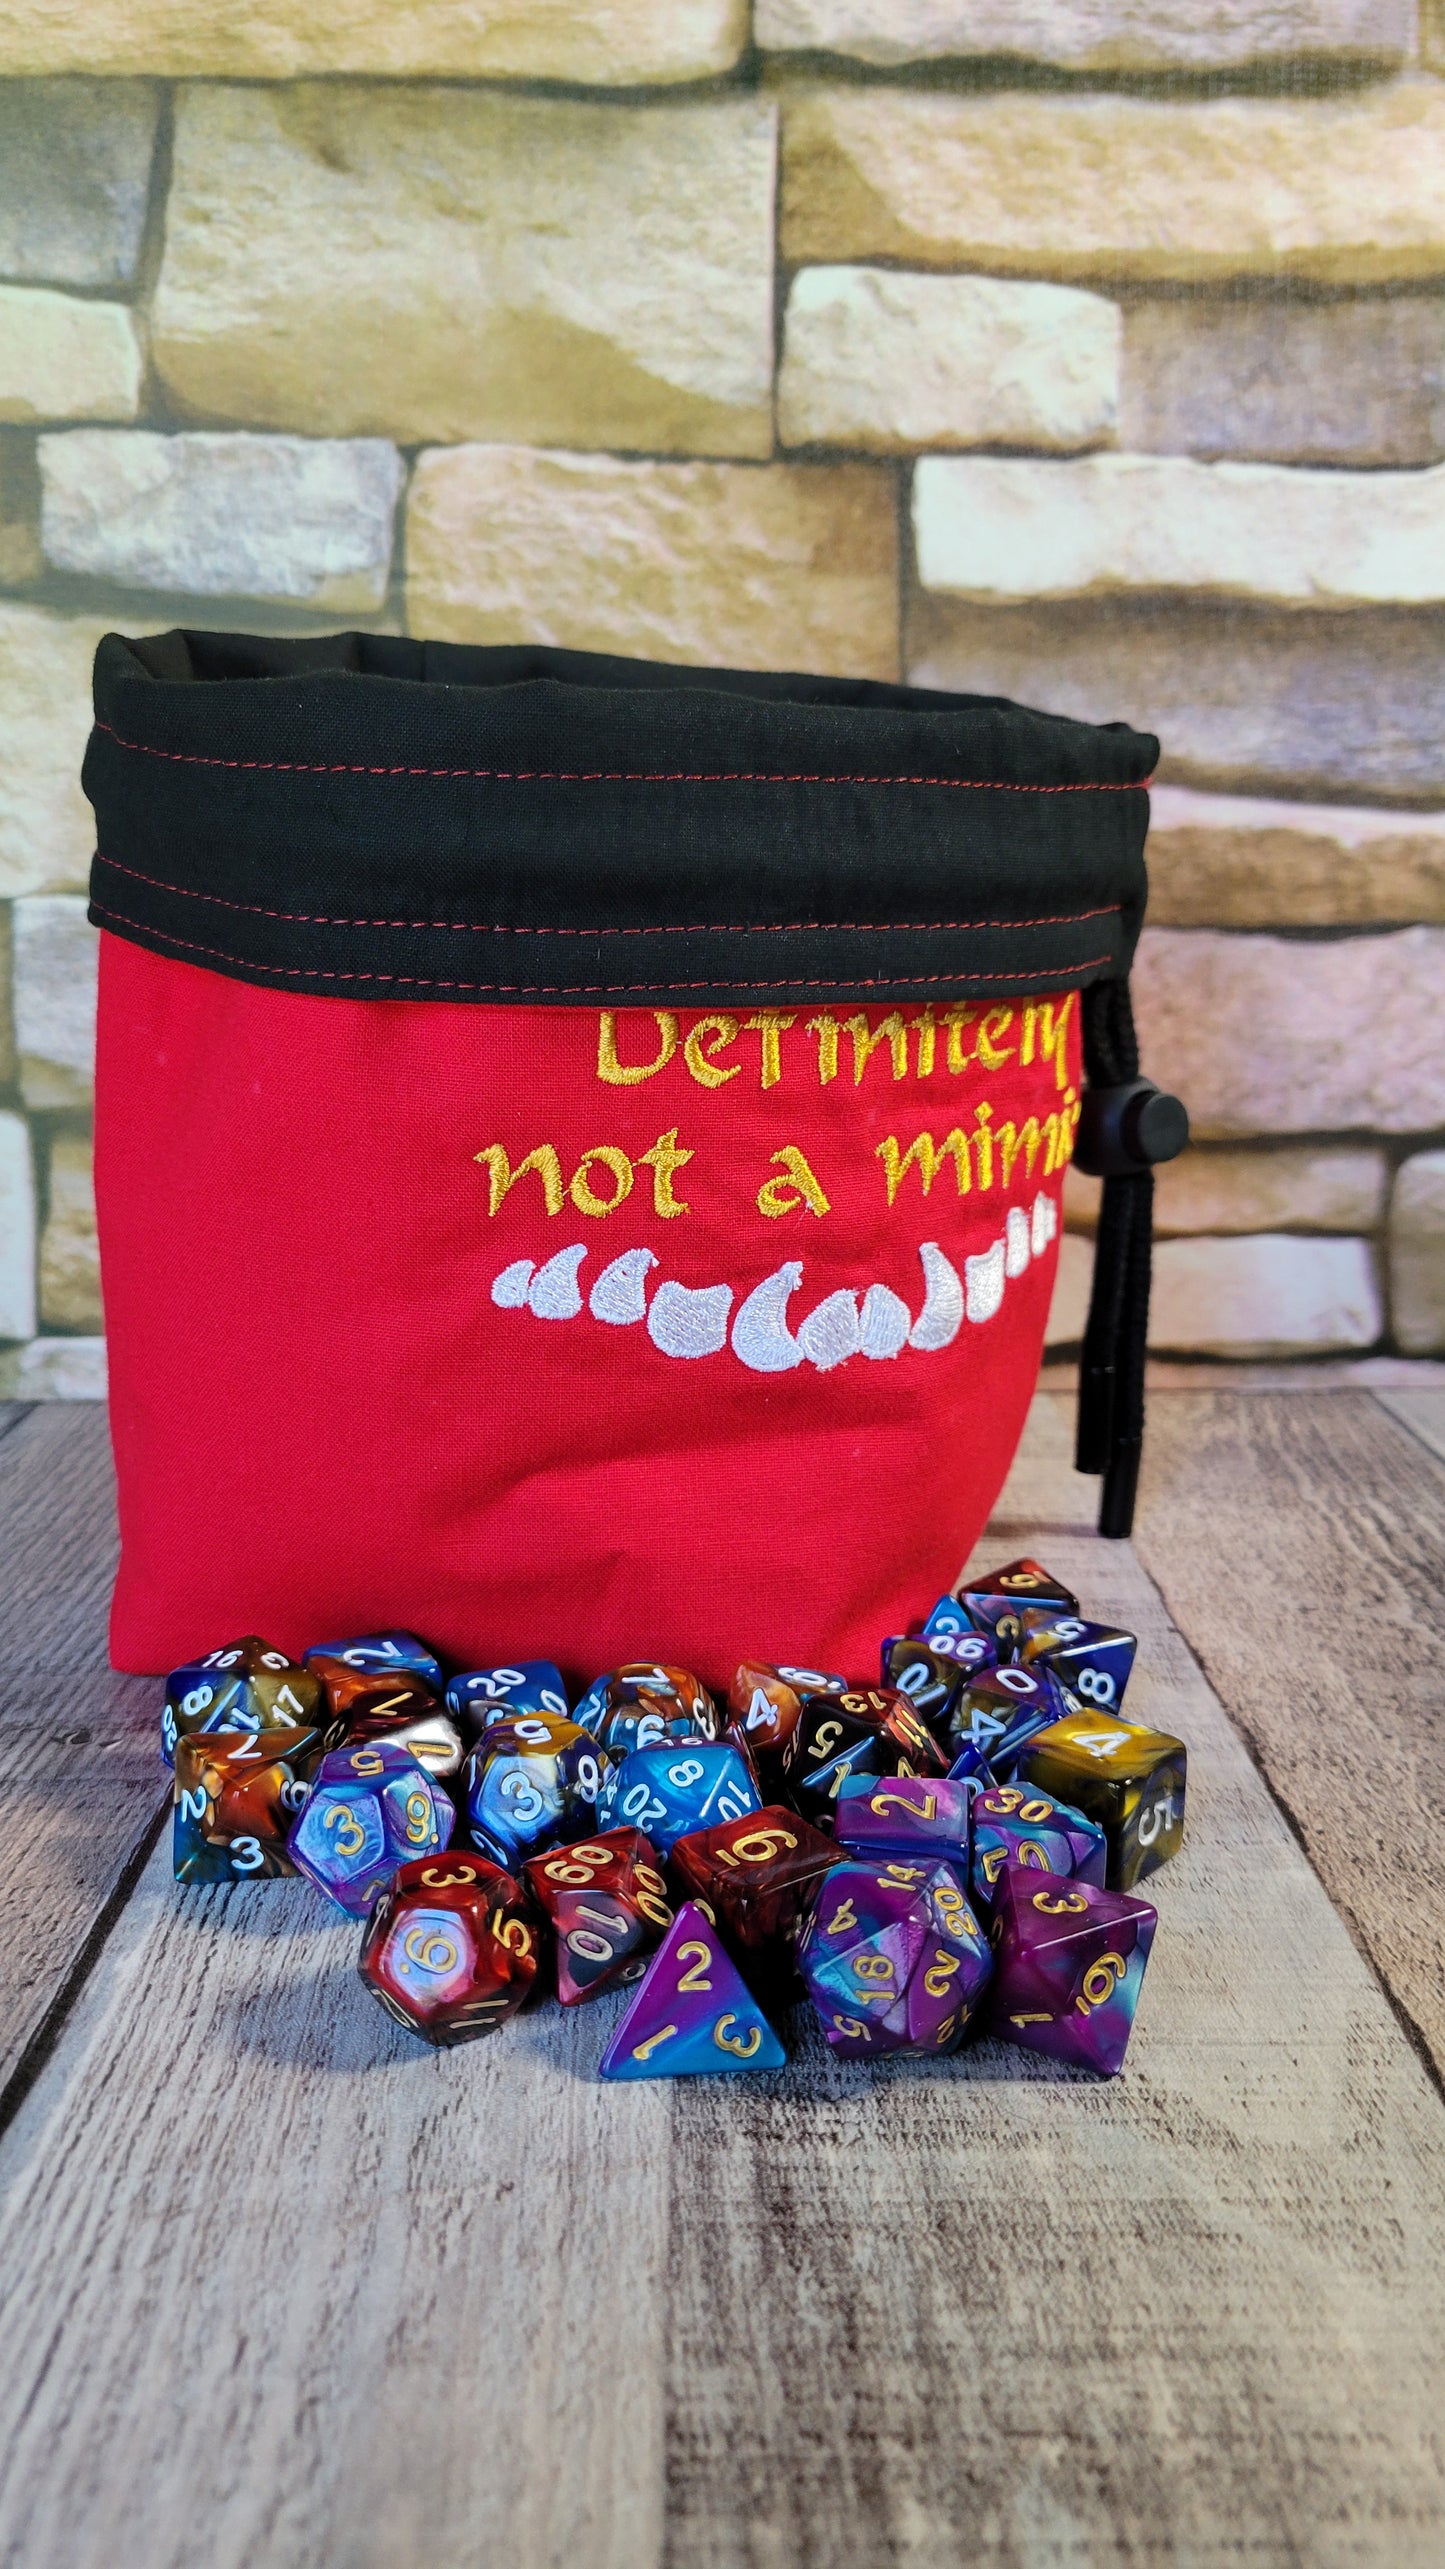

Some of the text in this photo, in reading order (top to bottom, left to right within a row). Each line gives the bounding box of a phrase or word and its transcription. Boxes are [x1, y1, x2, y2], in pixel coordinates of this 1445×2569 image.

[473, 1127, 694, 1219] not
[757, 1145, 830, 1219] a
[182, 1685, 213, 1716] 8
[467, 1669, 526, 1697] 20
[1078, 1668, 1116, 1703] 8
[272, 1684, 304, 1728] 17
[746, 1687, 778, 1730] 4
[808, 1721, 843, 1759] 5
[961, 1708, 1006, 1743] 4
[1072, 1731, 1132, 1757] 4
[350, 1751, 384, 1777] 5
[668, 1759, 704, 1787] 8
[182, 1786, 207, 1823] 2
[501, 1772, 543, 1820] 3
[623, 1783, 667, 1833] 20
[871, 1794, 938, 1820] 2
[984, 1788, 1053, 1822] 30
[324, 1805, 365, 1855] 3
[230, 1836, 264, 1870] 3
[421, 1866, 476, 1887] 3
[828, 1898, 858, 1934] 4
[933, 1887, 977, 1937] 20
[1033, 1892, 1088, 1914] 3
[492, 1909, 530, 1957] 5
[567, 1905, 628, 1961] 10
[676, 1941, 712, 1992] 2
[854, 1955, 895, 2005] 18
[924, 1949, 960, 1998] 2
[714, 2014, 762, 2058] 3
[1009, 2013, 1054, 2028] 1
[632, 2025, 678, 2060] 1
